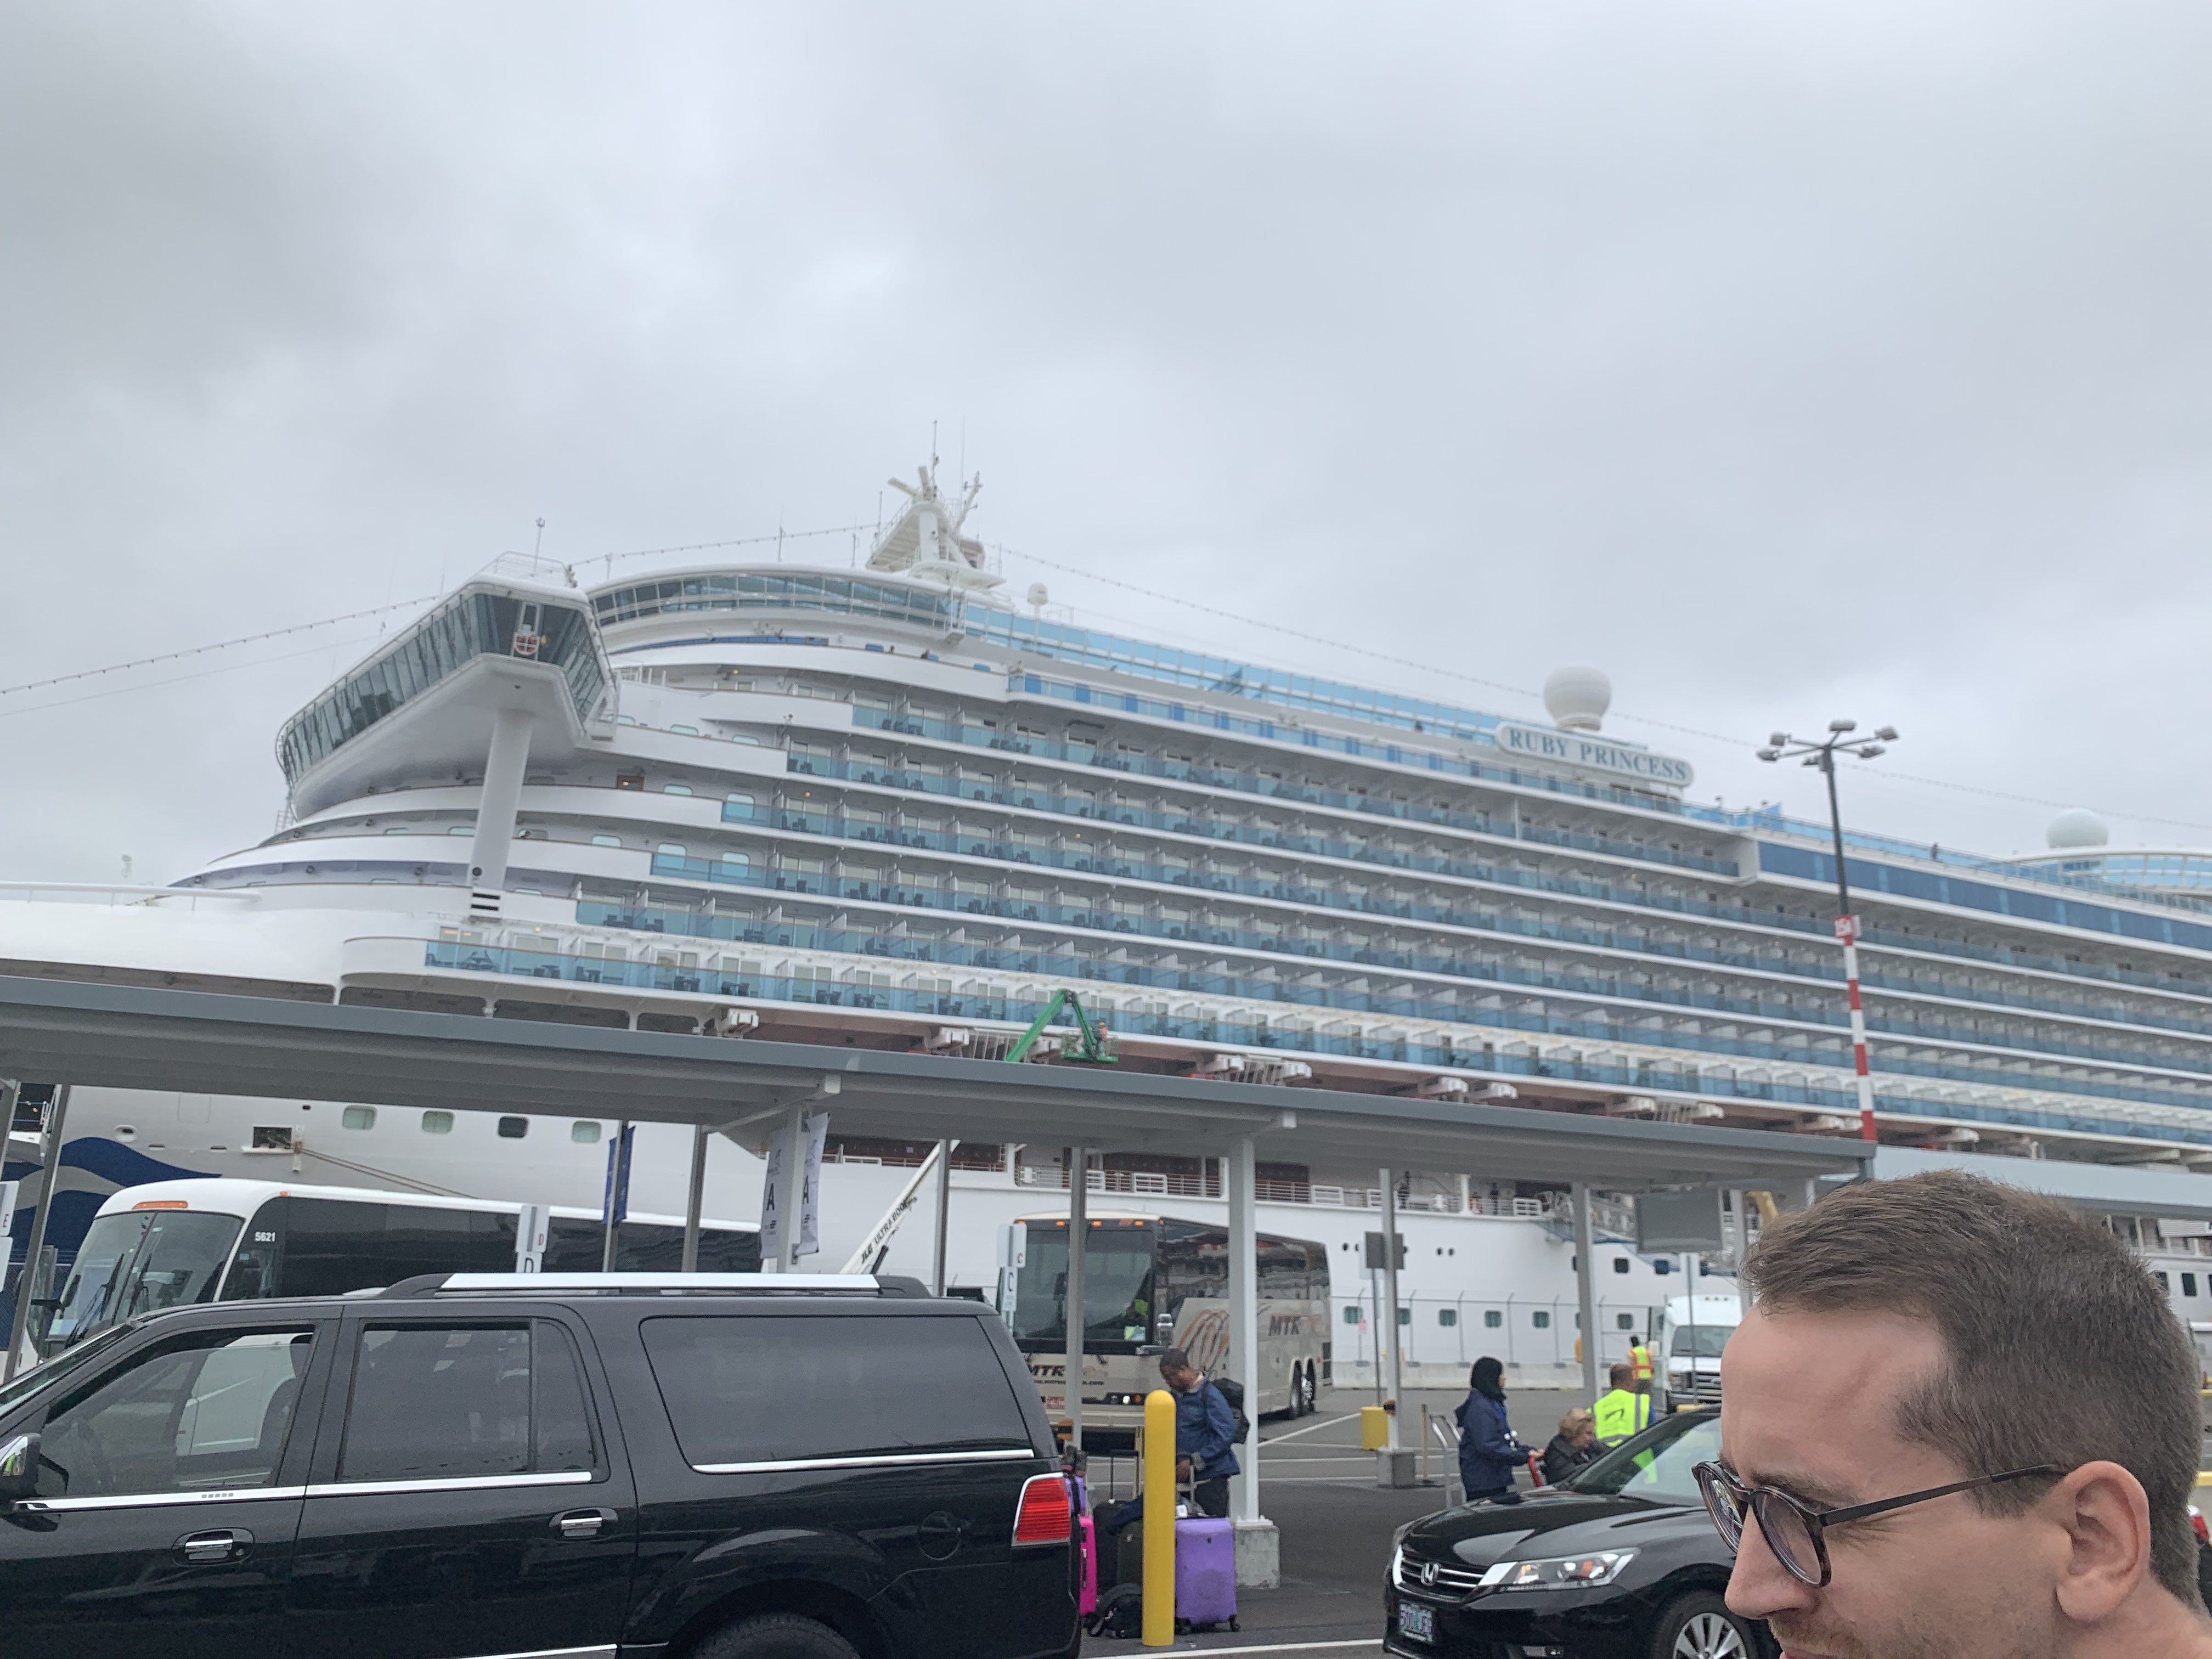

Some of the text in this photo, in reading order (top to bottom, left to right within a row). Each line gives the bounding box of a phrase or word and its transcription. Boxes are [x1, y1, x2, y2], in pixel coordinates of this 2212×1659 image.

[1510, 729, 1687, 781] RUBY PRINCESS
[766, 1182, 775, 1211] A
[802, 1175, 809, 1204] A
[2, 1214, 9, 1228] E
[255, 1231, 275, 1242] 5621
[538, 1233, 544, 1246] D
[861, 1243, 873, 1264] JLG
[874, 1218, 893, 1244] ULTRA
[1008, 1272, 1014, 1292] C
